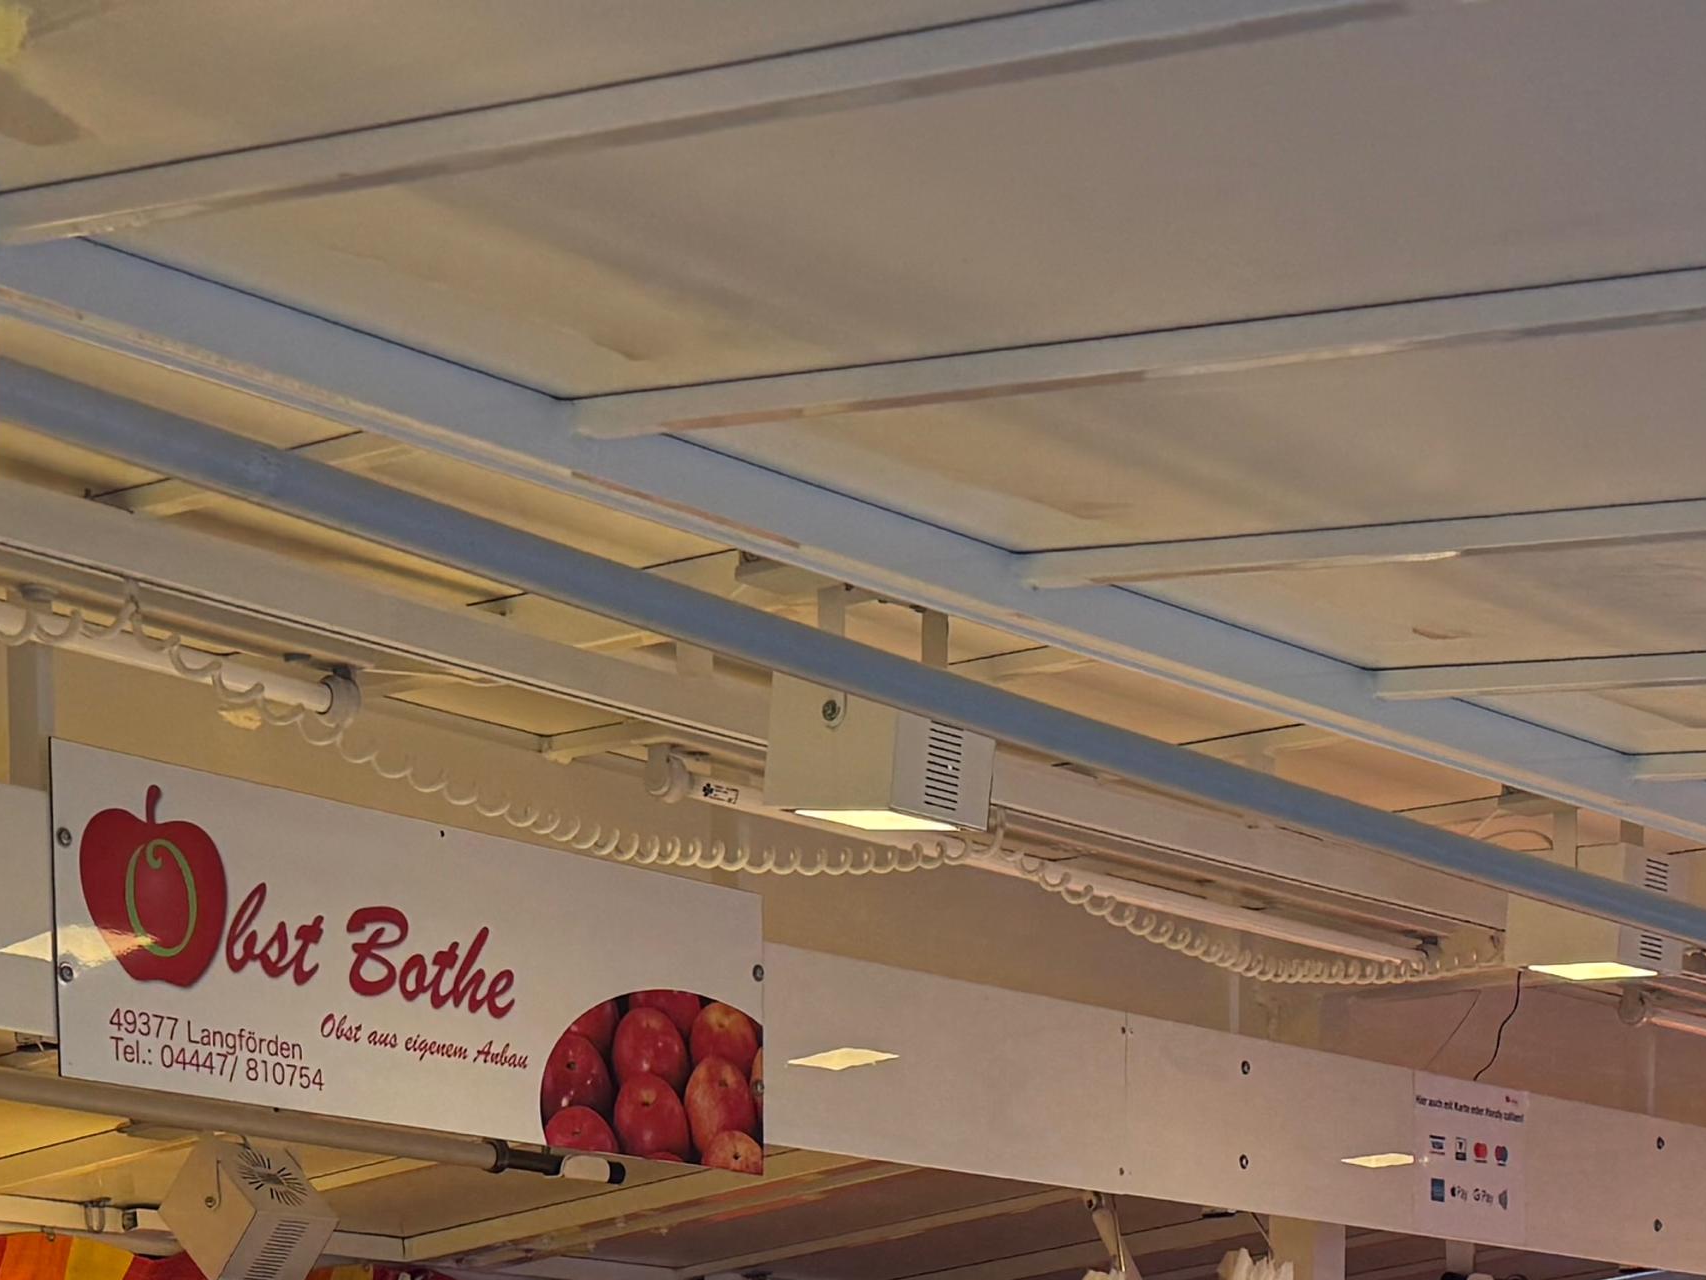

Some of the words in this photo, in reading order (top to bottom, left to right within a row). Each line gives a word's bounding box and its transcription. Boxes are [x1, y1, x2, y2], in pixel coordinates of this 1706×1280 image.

[124, 838, 325, 986] Obst
[345, 905, 516, 1020] Bothe
[109, 1007, 179, 1044] 49377
[187, 1018, 304, 1063] Langförden
[319, 1012, 361, 1043] Obst
[368, 1031, 398, 1049] aus
[404, 1036, 469, 1063] eigenem
[473, 1041, 529, 1071] Anbau
[110, 1036, 154, 1069] Tel.:
[160, 1046, 238, 1083] 04447/
[245, 1058, 326, 1093] 810754
